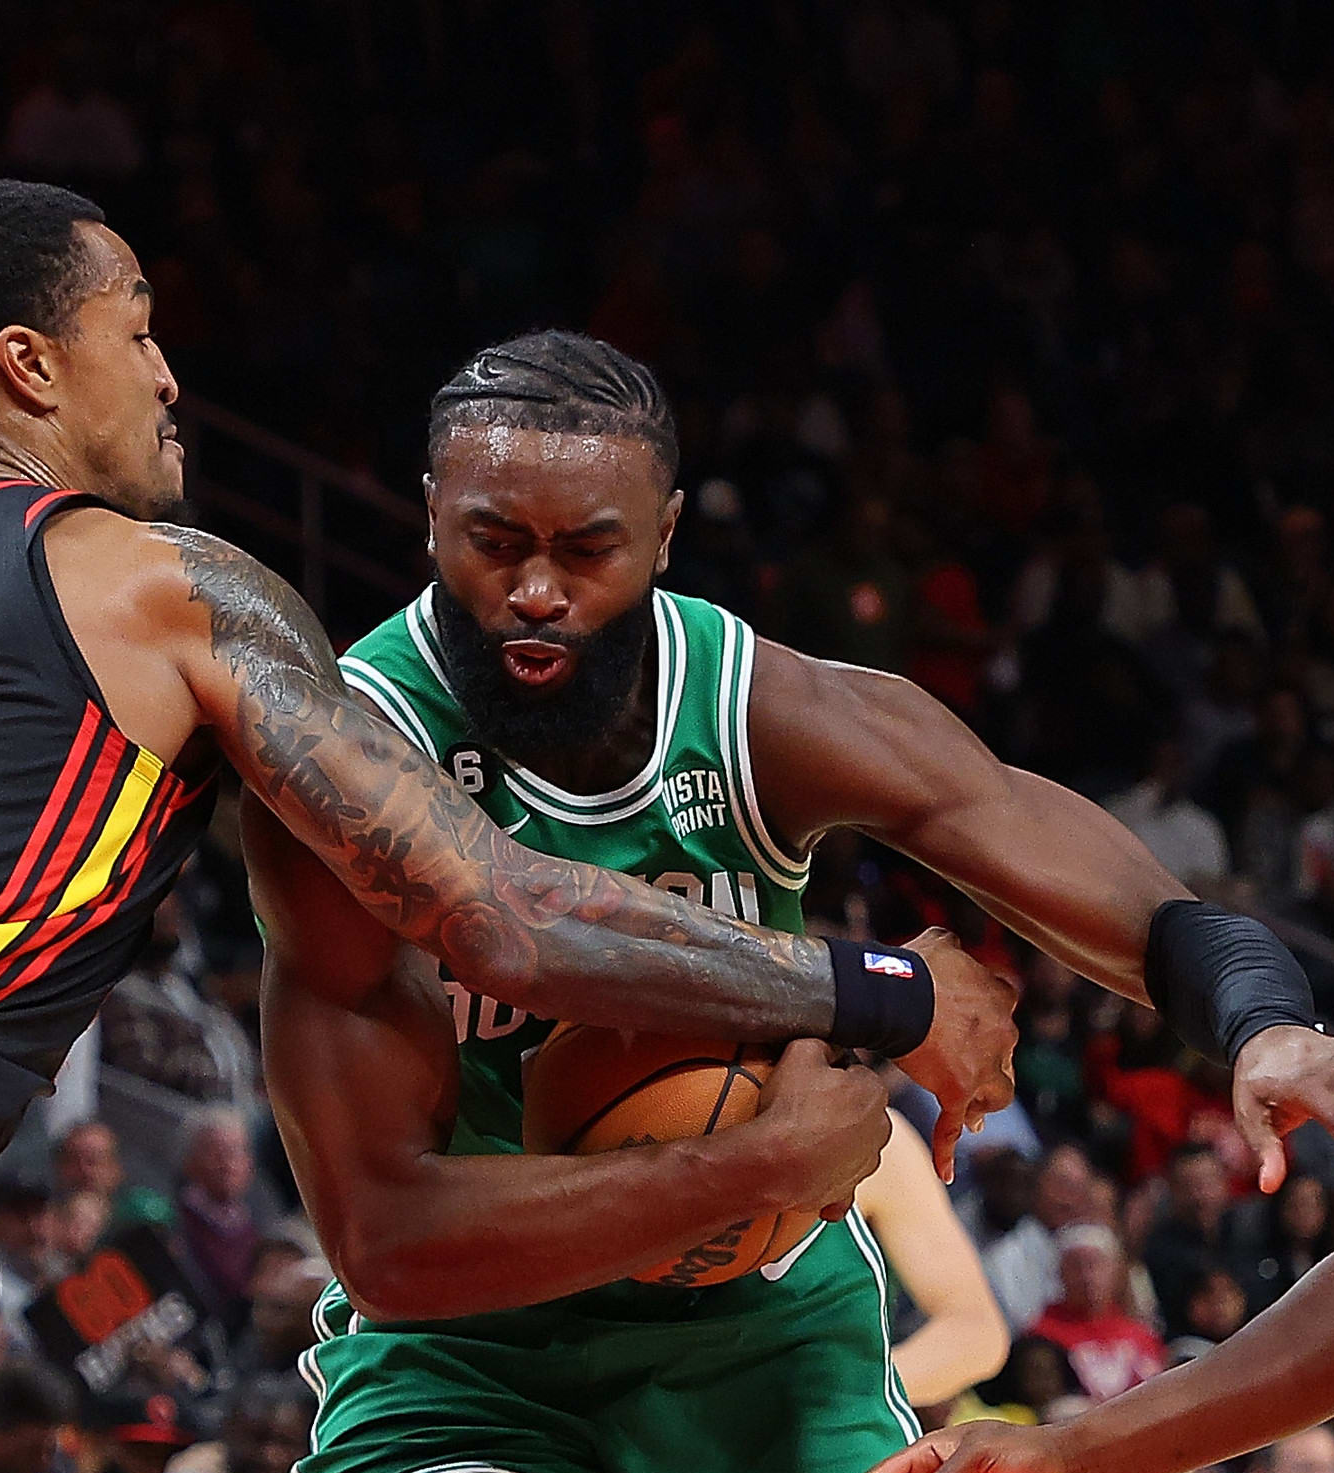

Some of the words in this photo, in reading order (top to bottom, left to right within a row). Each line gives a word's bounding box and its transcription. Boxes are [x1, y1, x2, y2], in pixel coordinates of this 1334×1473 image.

[453, 750, 485, 793] 6
[661, 769, 725, 816] VISTA
[671, 803, 727, 841] PRINT
